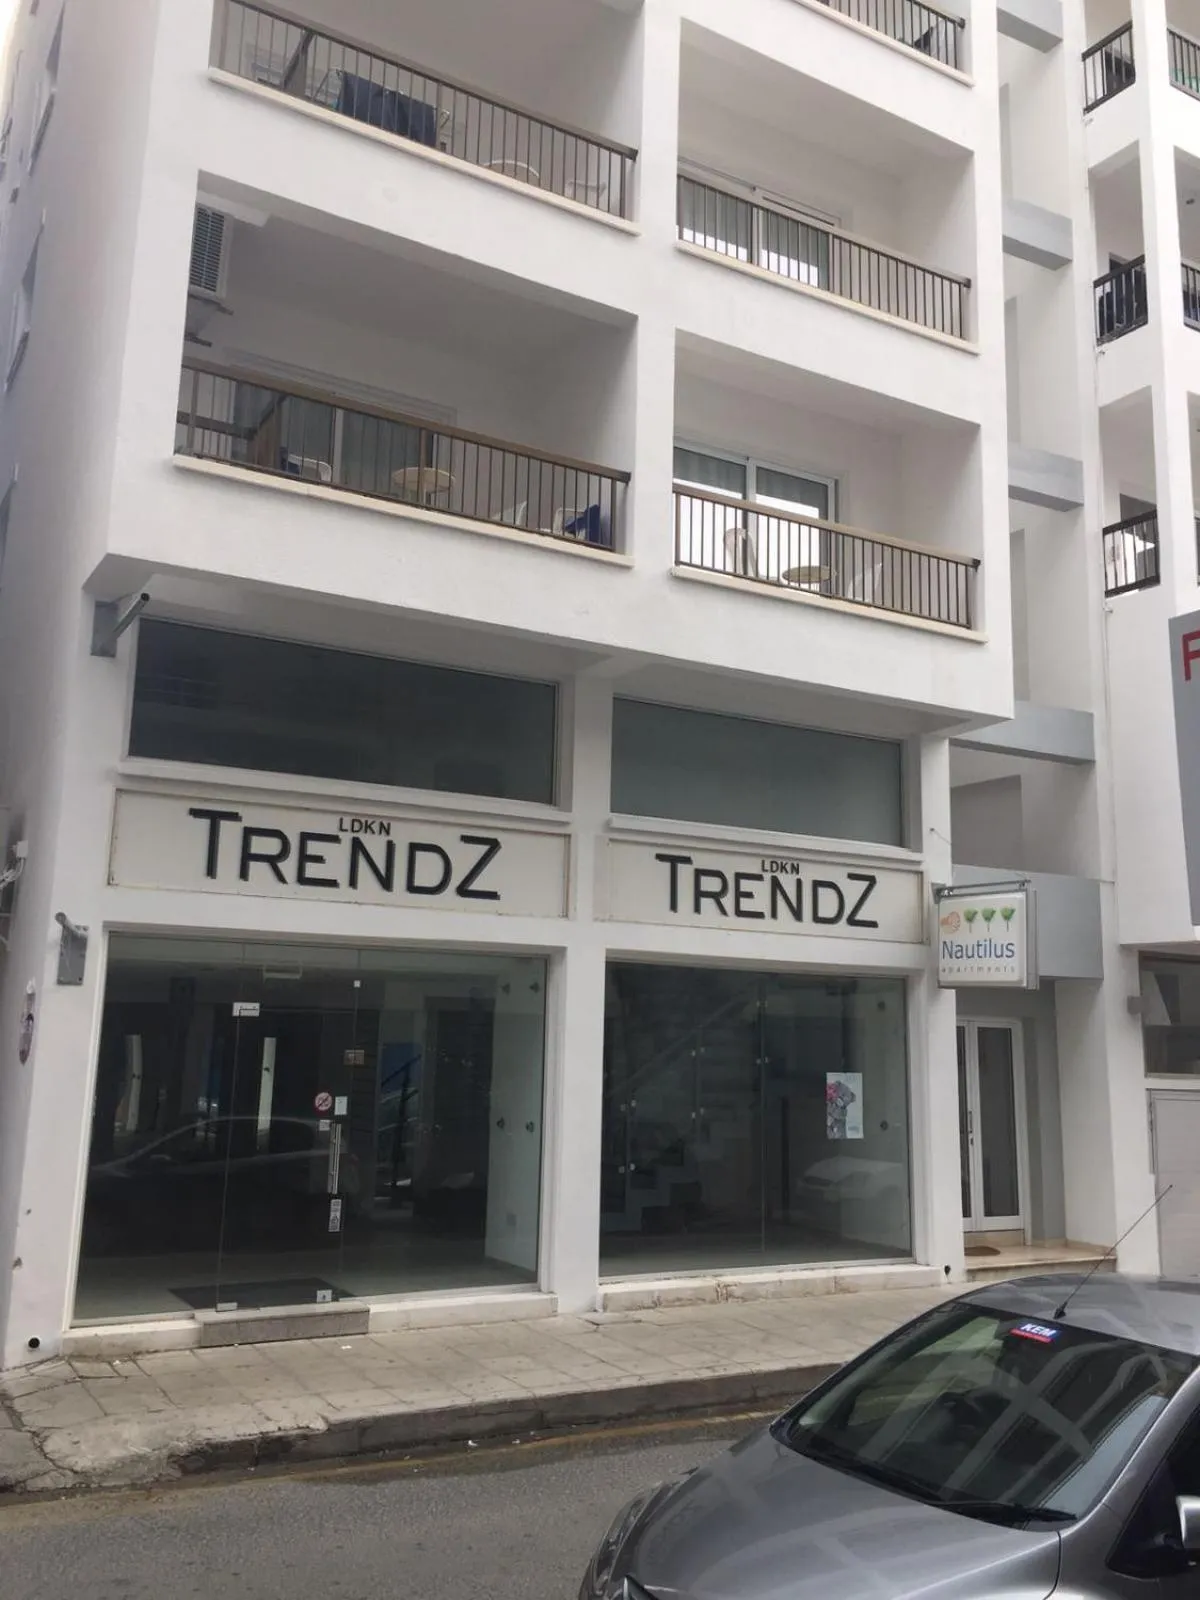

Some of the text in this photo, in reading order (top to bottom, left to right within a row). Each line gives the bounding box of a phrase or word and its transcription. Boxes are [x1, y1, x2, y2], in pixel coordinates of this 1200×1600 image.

[338, 816, 392, 837] LDKN
[188, 807, 502, 901] TRENDZ
[761, 858, 800, 876] LDKN
[655, 852, 879, 929] TRENDZ
[942, 938, 1015, 960] Nautilus
